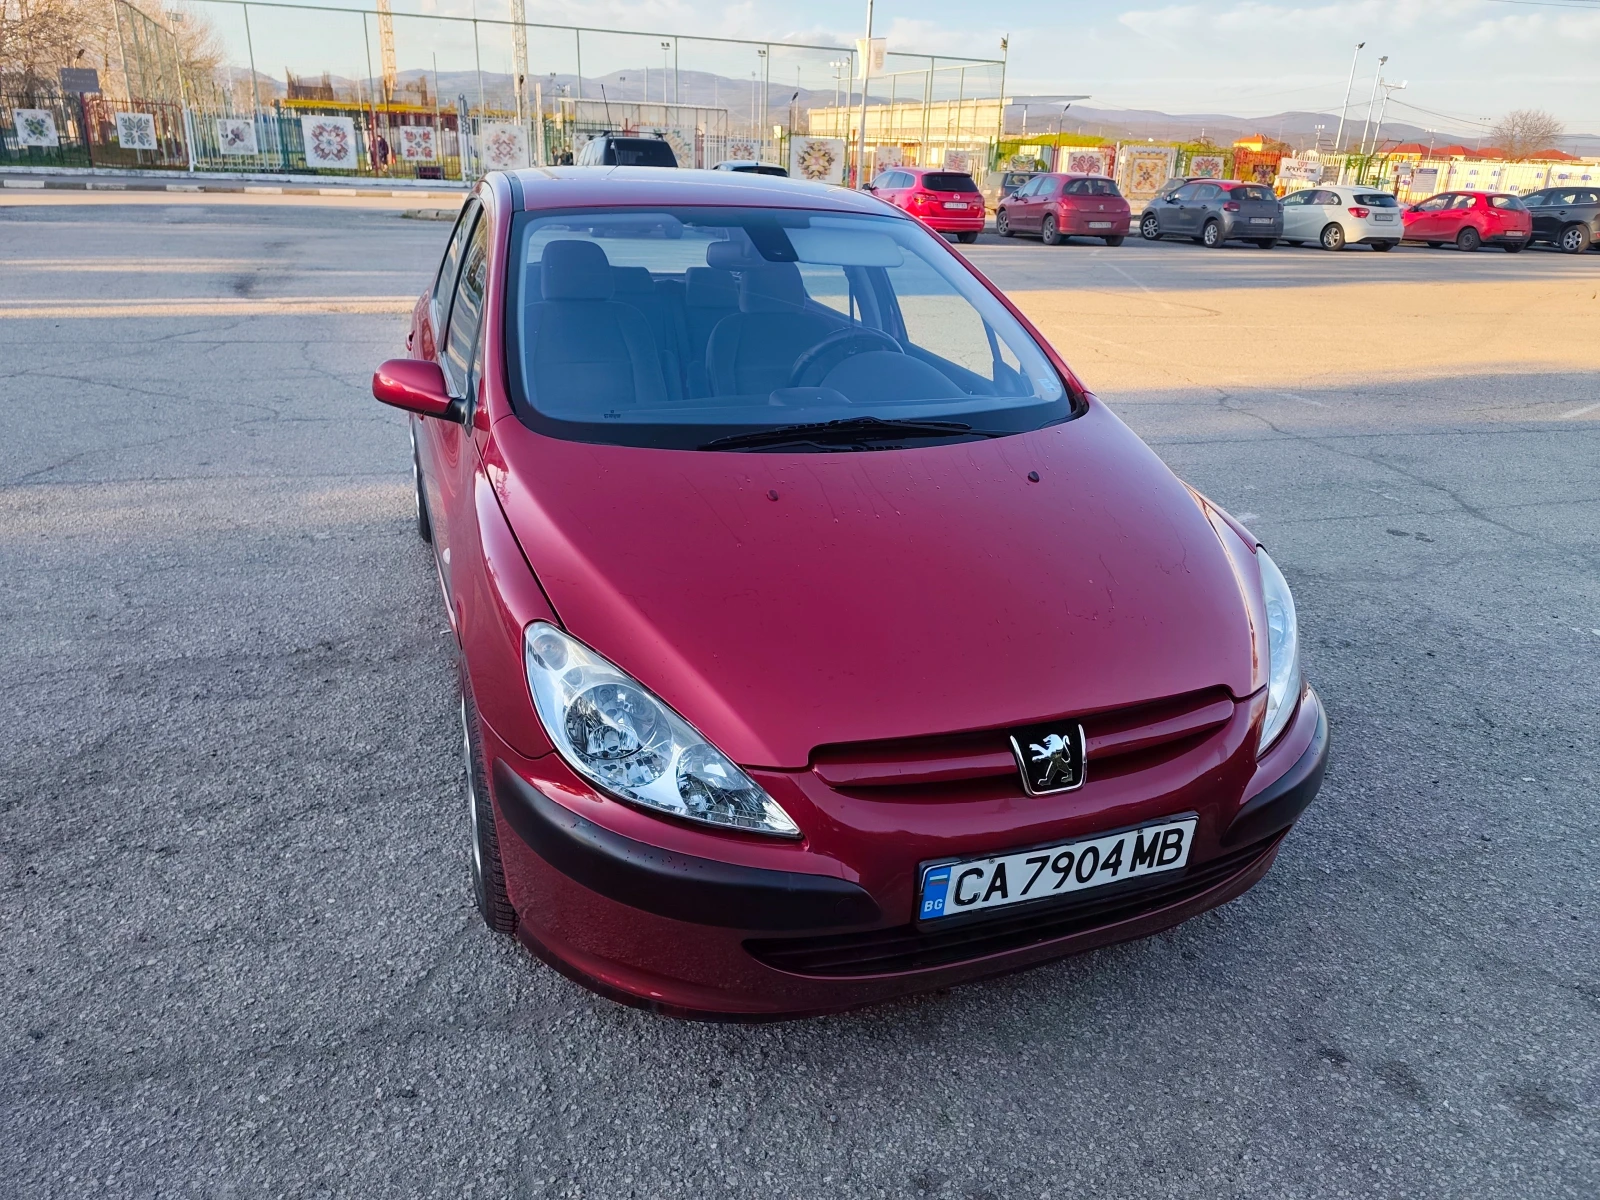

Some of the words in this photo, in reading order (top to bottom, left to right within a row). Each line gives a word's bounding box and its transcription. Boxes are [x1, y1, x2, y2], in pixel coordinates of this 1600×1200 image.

[953, 862, 1009, 907] CA
[1020, 838, 1126, 897] 7904
[1129, 827, 1185, 873] MB
[923, 898, 944, 913] BG
